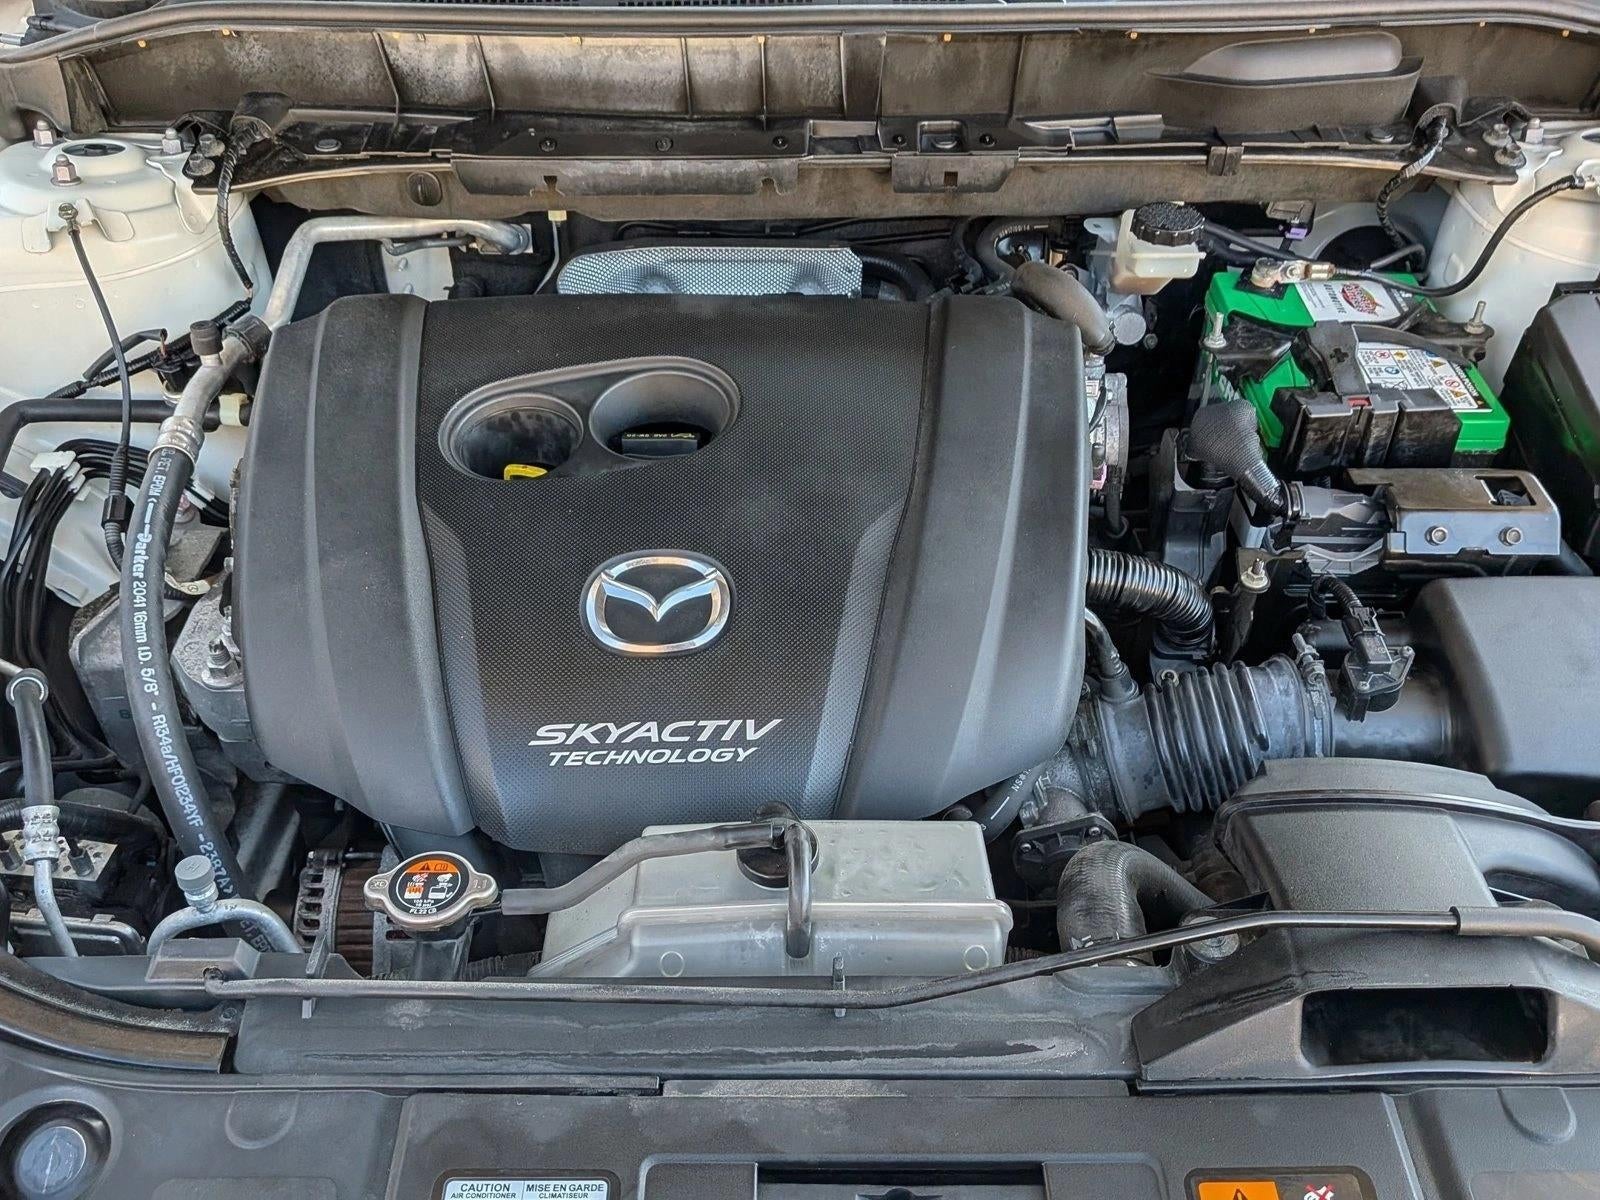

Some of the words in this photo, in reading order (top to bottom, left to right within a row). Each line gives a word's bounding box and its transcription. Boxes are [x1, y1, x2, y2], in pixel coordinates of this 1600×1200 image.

[132, 581, 147, 608] 2041
[133, 611, 148, 643] 16mm
[137, 646, 153, 664] I.D.
[528, 718, 783, 746] SKYACTIV
[549, 747, 759, 767] TECHNOLOGY
[460, 1183, 511, 1192] CAUTION
[525, 1183, 551, 1192] MISE
[552, 1183, 568, 1192] EN
[568, 1183, 604, 1192] GARDE
